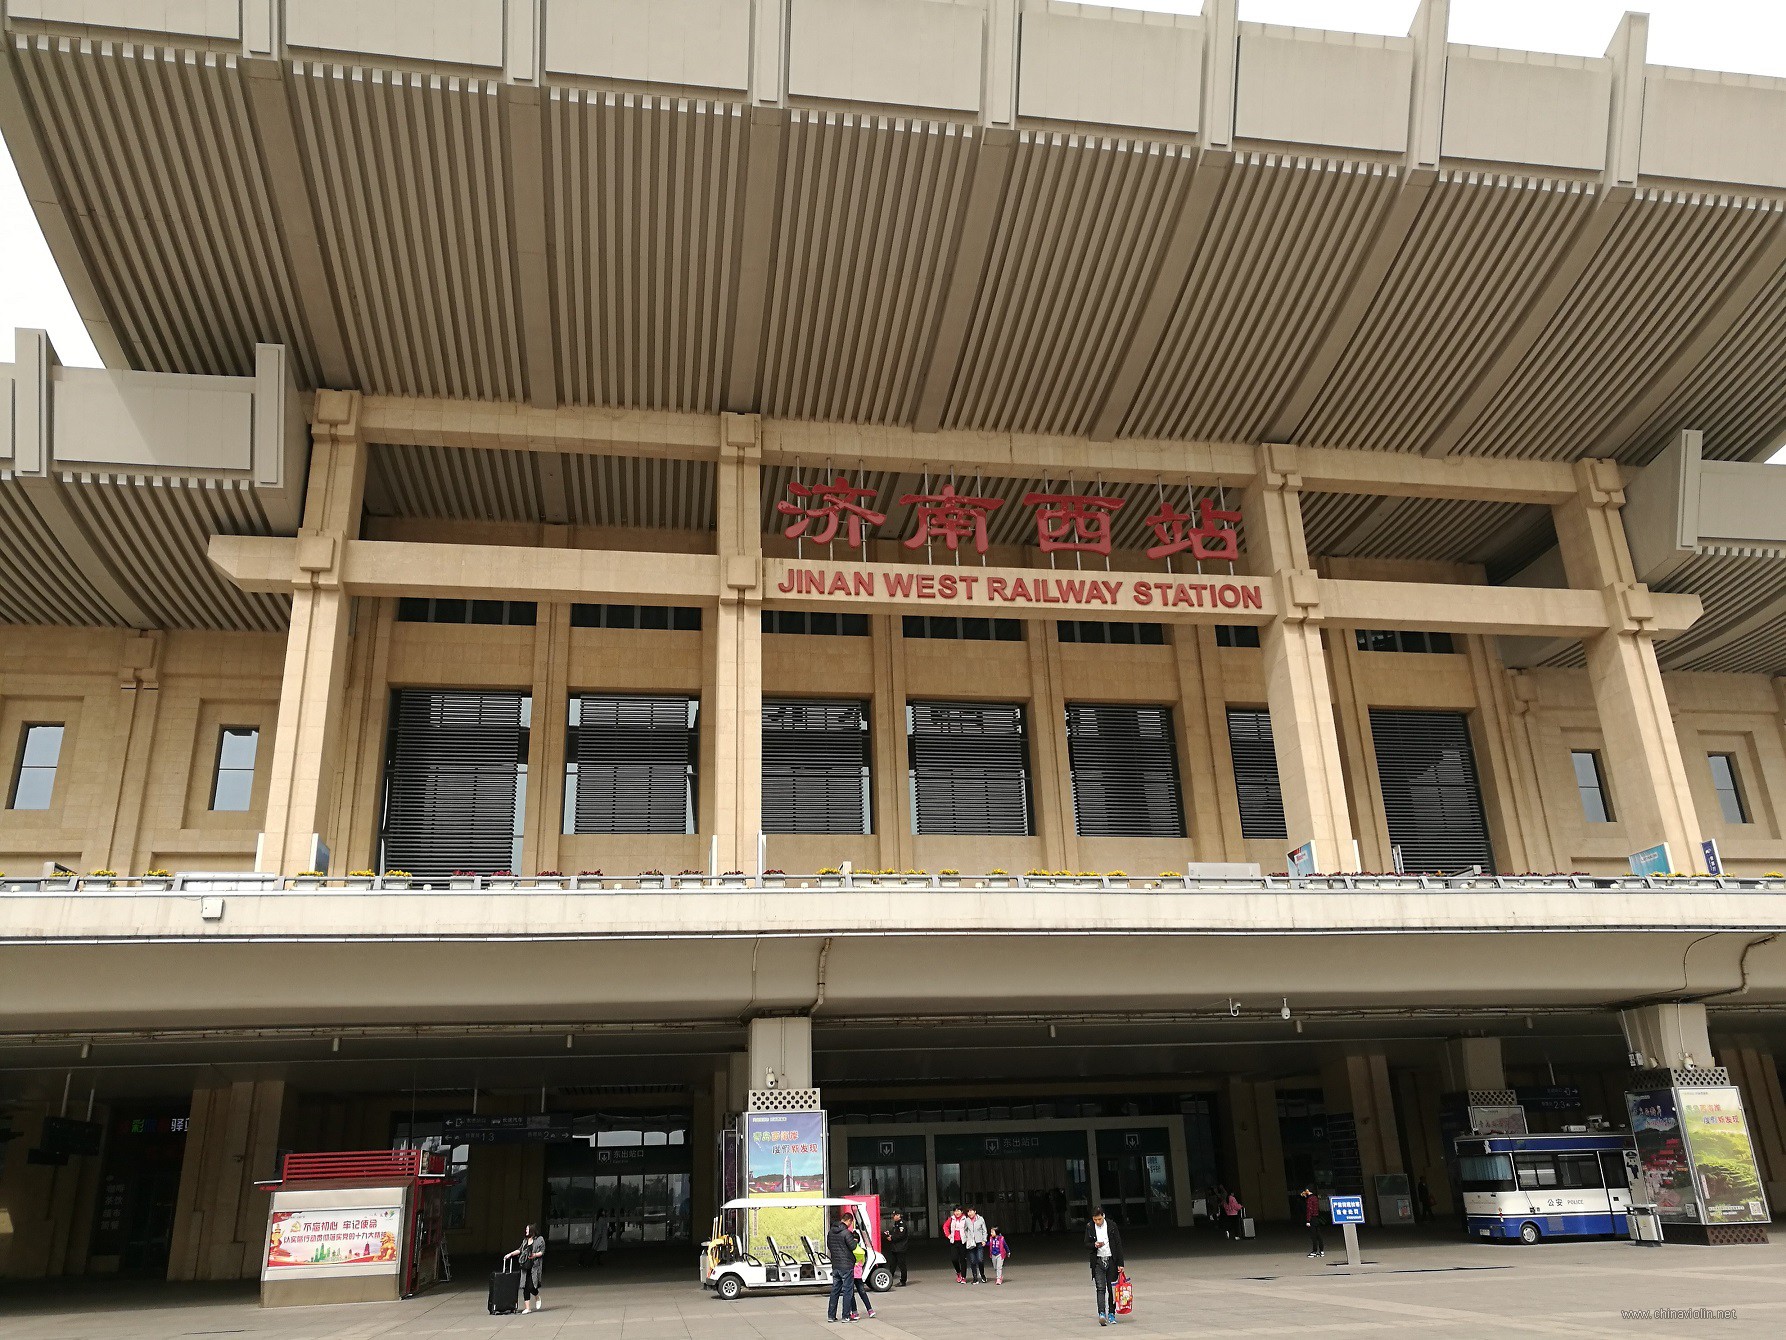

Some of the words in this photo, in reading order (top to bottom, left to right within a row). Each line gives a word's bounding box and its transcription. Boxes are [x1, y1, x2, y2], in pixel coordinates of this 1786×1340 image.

[776, 477, 1243, 561] 济南西站
[778, 568, 874, 597] JINAN
[883, 572, 979, 600] WEST
[987, 576, 1123, 605] RAILWAY
[1133, 580, 1263, 609] STATION
[1003, 1137, 1039, 1147] 东出站口
[613, 1150, 644, 1159] 东出站口
[1547, 1198, 1563, 1207] 公安
[303, 1221, 338, 1232] 不忘初心
[343, 1219, 378, 1230] 牢记使命
